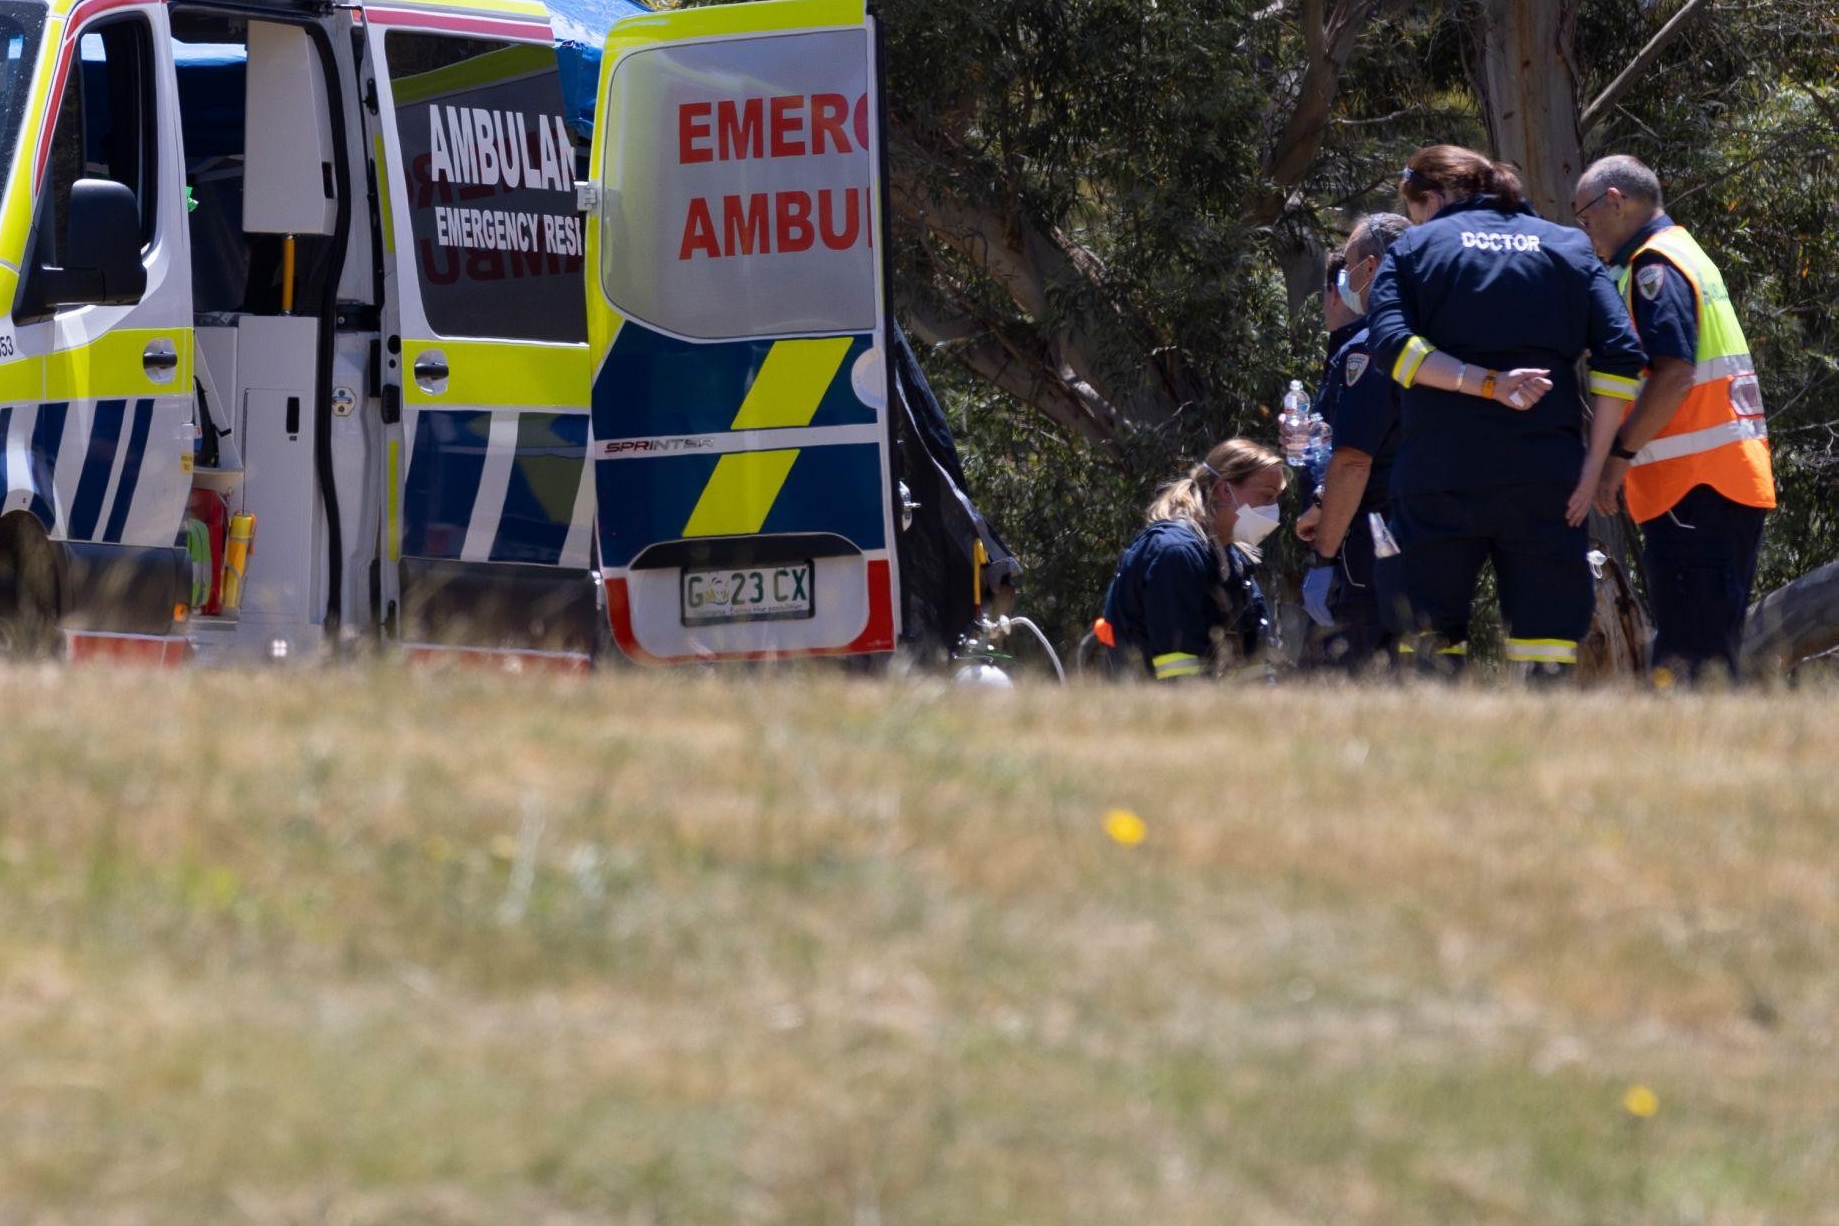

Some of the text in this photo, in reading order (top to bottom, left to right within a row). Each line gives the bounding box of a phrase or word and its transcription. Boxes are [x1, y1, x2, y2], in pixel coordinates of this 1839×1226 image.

[435, 206, 539, 253] EMERGENCY
[679, 187, 873, 260] AMBU
[1461, 231, 1541, 252] DOCTOR
[605, 437, 716, 454] SPRINTER
[688, 568, 807, 609] G 23 CX
